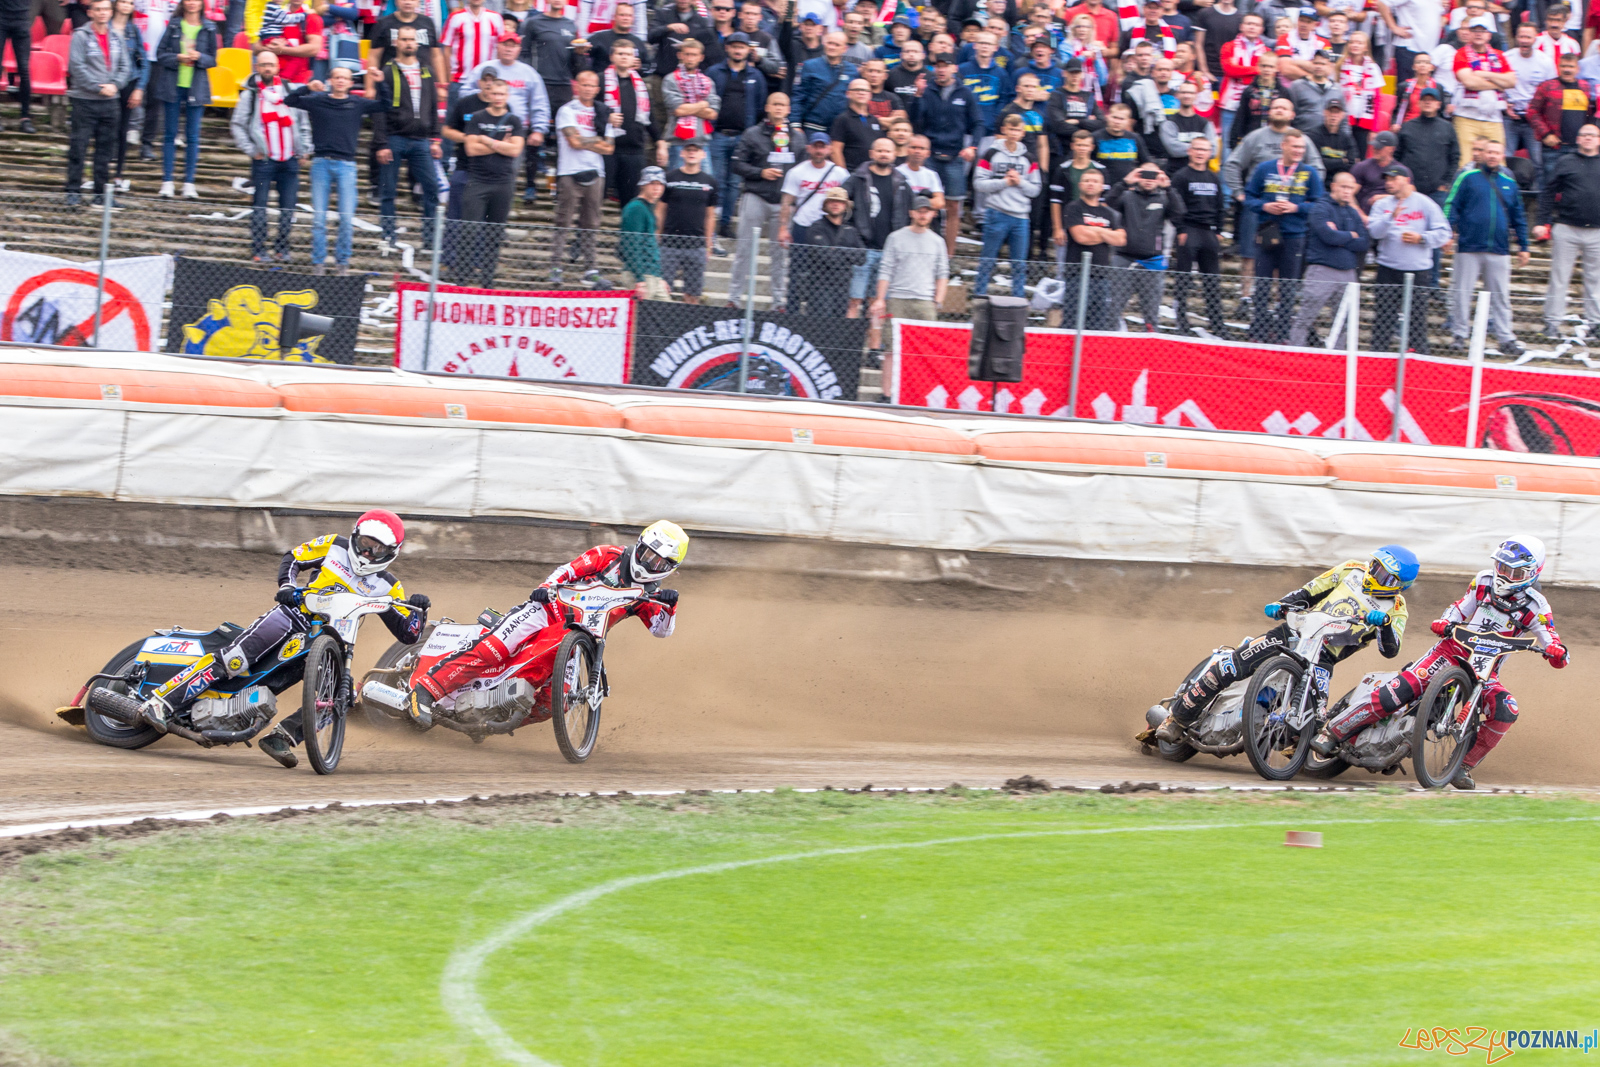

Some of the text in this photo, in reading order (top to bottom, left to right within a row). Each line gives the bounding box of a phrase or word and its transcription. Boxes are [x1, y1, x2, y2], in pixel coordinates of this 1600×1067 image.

[503, 304, 619, 328] BYDGOSZCZ
[502, 605, 542, 641] FRANCEPOL
[1239, 636, 1284, 661] STILL
[1427, 656, 1448, 676] CLIMA
